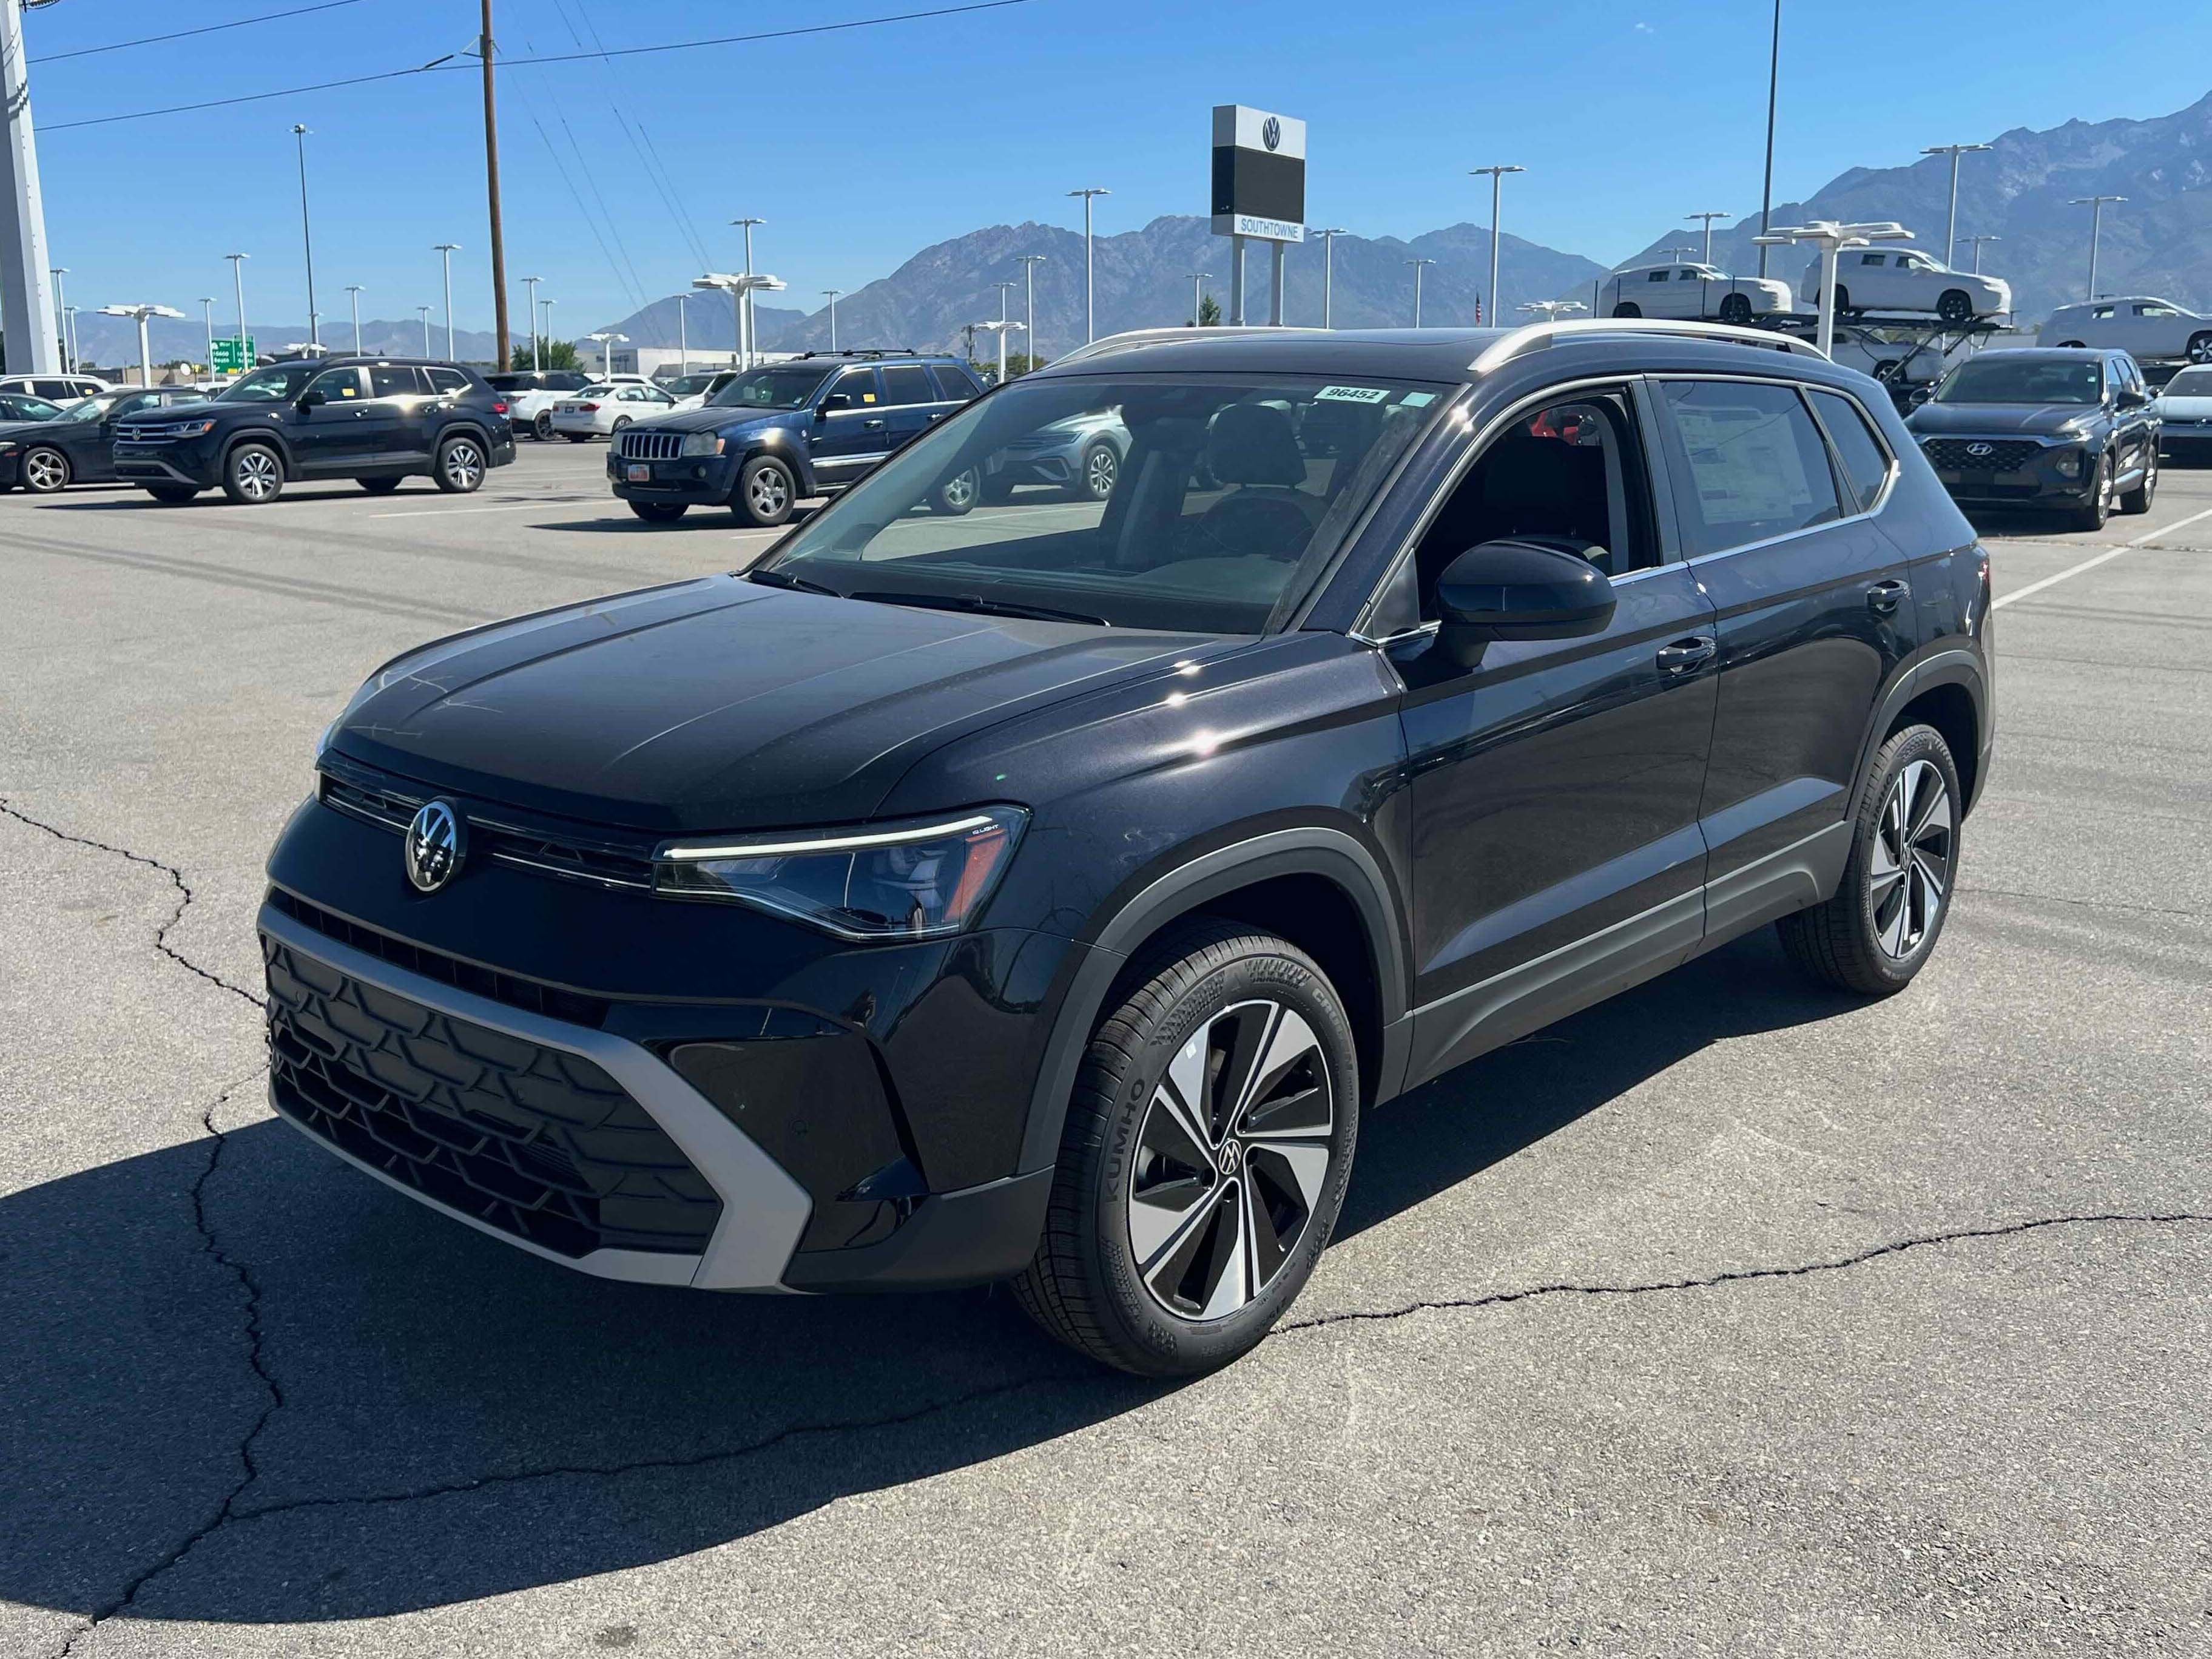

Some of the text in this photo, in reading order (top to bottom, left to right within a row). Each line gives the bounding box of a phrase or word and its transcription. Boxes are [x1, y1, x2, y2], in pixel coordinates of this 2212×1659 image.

[1241, 218, 1298, 238] SOUTHTOWNE
[1327, 388, 1380, 399] 96452
[1106, 1078, 1145, 1202] KUMHO
